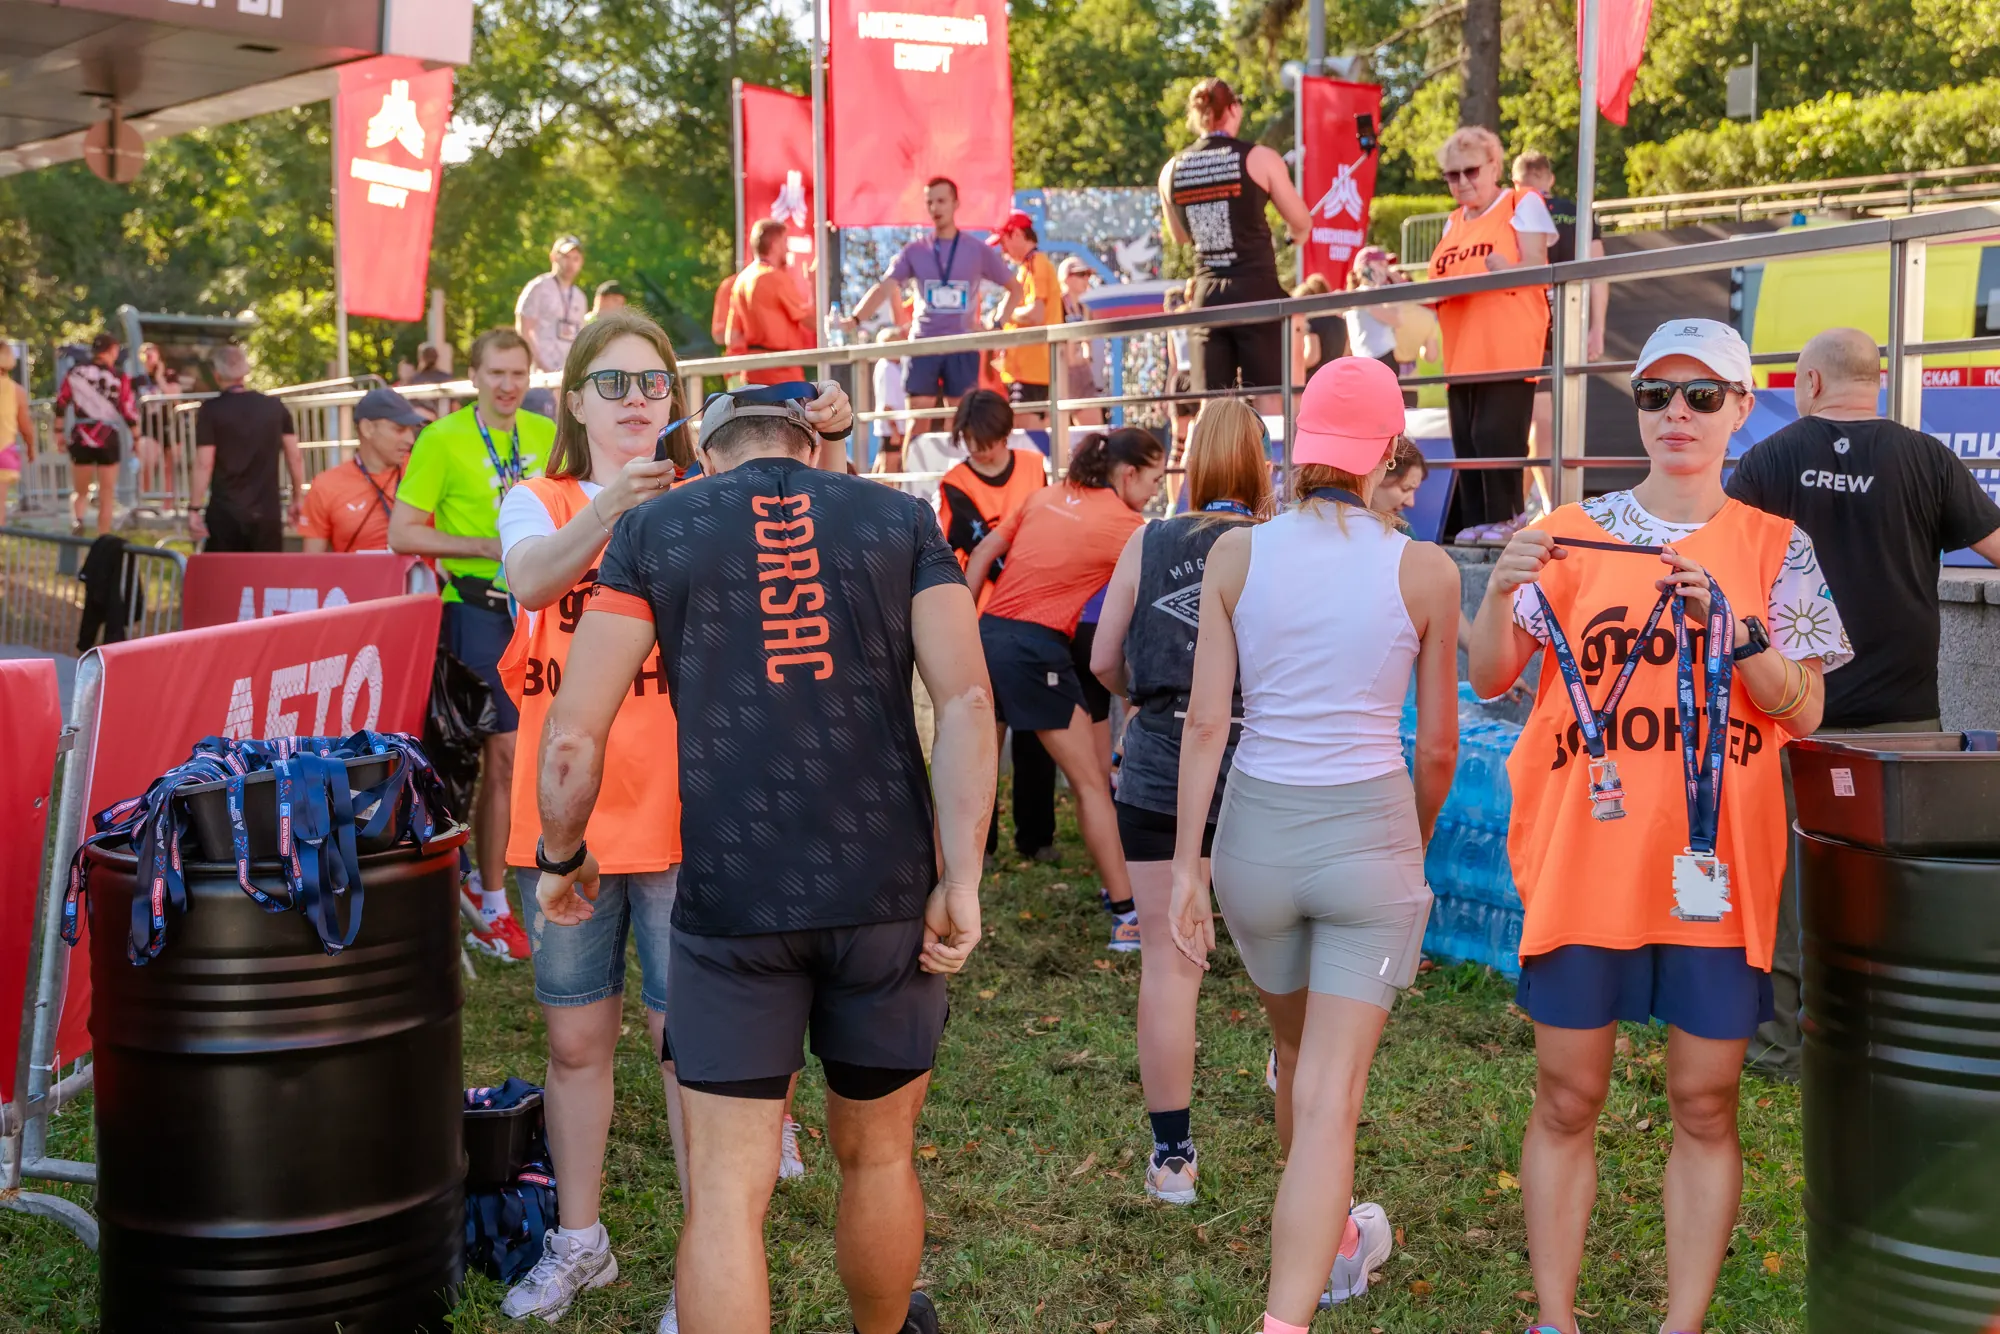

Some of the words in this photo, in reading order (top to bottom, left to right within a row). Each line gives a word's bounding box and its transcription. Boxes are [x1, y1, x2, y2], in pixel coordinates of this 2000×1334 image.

[1800, 469, 1874, 494] CREW
[751, 493, 834, 684] CORSAC
[222, 644, 383, 740] ЛЕТО
